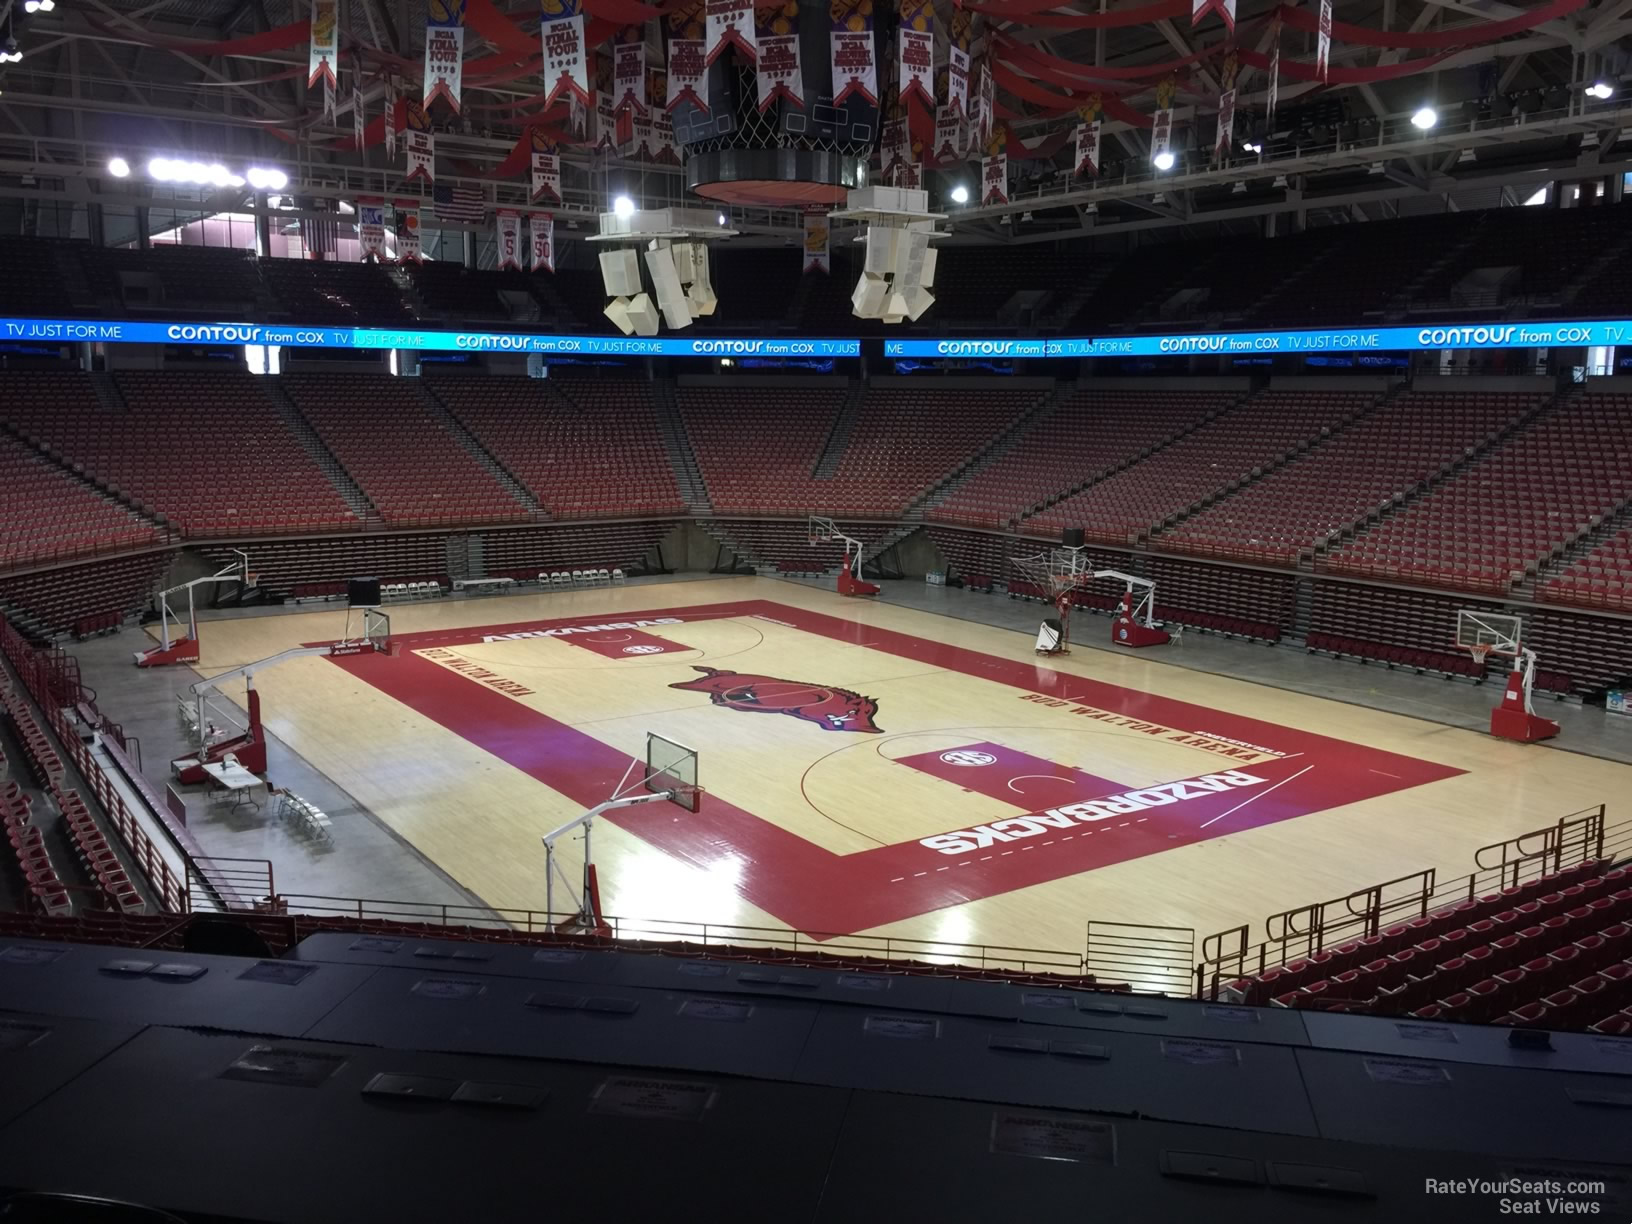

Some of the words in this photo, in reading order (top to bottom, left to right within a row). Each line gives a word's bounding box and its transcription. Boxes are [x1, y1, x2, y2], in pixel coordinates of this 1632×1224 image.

[434, 30, 455, 40] NCAA
[550, 22, 572, 32] NCAA
[428, 40, 459, 51] FINAL
[546, 30, 578, 46] FINAL
[429, 51, 458, 62] FOUR
[548, 43, 578, 58] FOUR
[506, 239, 514, 256] 5
[535, 241, 550, 258] 50
[6, 323, 25, 336] TV
[28, 324, 63, 337] JUST
[66, 326, 97, 338] FOR
[100, 326, 122, 338] ME
[264, 330, 293, 343] from
[296, 333, 325, 344] COX
[333, 333, 348, 344] TV
[350, 334, 381, 345] JUST
[382, 335, 407, 346] FOR
[408, 336, 425, 347] ME
[533, 339, 556, 350] from
[558, 340, 581, 350] COX
[588, 342, 600, 351] TV
[602, 342, 624, 352] JUST
[626, 342, 646, 352] FOR
[647, 343, 663, 352] ME
[766, 342, 788, 353] from
[790, 344, 814, 353] COX
[822, 344, 834, 353] TV
[836, 344, 860, 353] JUST
[887, 344, 904, 354] ME
[1016, 344, 1040, 354] from
[1042, 344, 1062, 354] COX
[1068, 344, 1078, 354] TV
[1080, 342, 1099, 353] JUST
[1100, 342, 1119, 352] FOR
[1119, 341, 1132, 352] ME
[1230, 338, 1252, 350] from
[1254, 338, 1280, 349] COX
[1288, 336, 1302, 348] TV
[1303, 336, 1330, 348] JUST
[1332, 335, 1358, 347] FOR
[1360, 334, 1380, 346] ME
[1520, 328, 1552, 342] from
[1556, 328, 1592, 342] COX
[1604, 326, 1624, 341] TV
[482, 617, 684, 643] ARKANSAS
[441, 658, 498, 678] WALTON
[482, 678, 536, 696] ARENA
[1018, 694, 1070, 708] BUD
[1068, 706, 1171, 736] WALTON
[1167, 735, 1261, 761] ARENA
[919, 770, 1270, 856] RAZORBACKS
